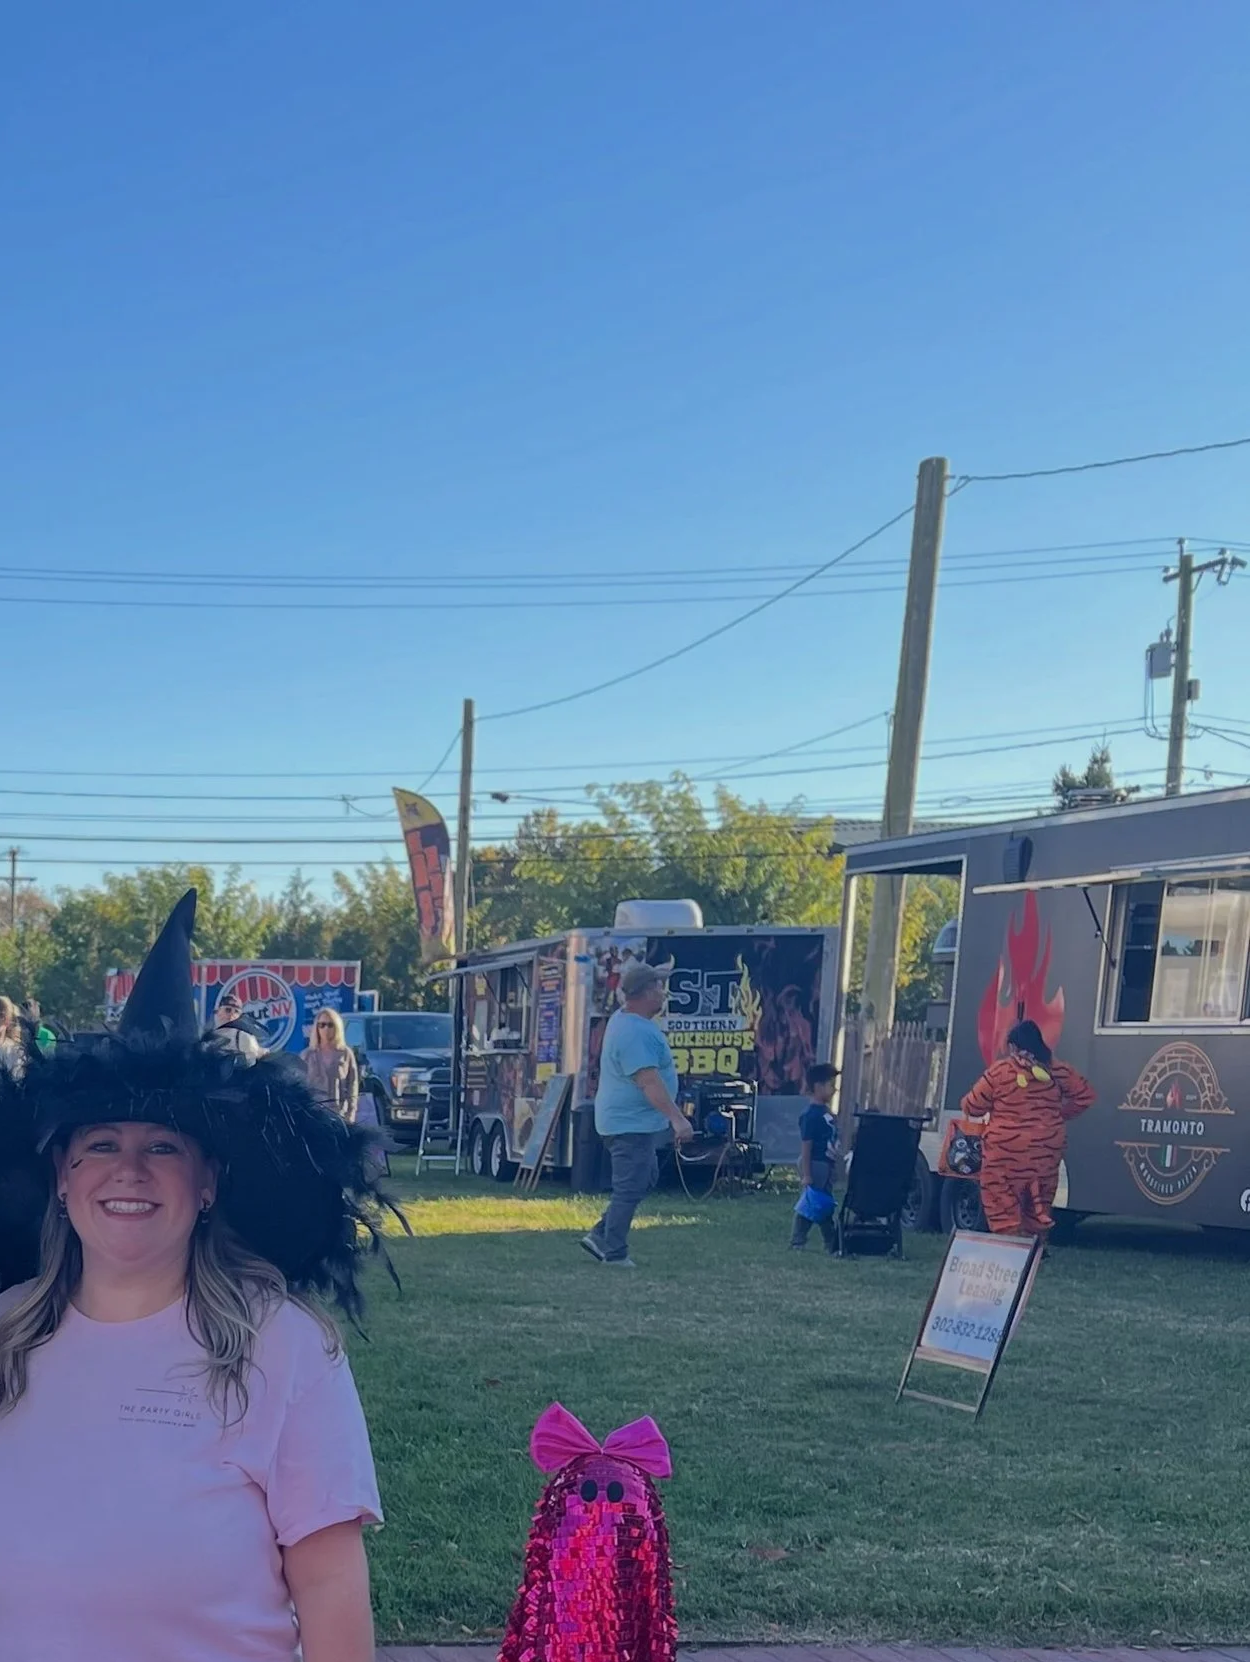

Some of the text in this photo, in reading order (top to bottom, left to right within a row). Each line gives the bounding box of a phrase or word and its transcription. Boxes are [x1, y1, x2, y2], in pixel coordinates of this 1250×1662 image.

[668, 1020, 737, 1030] SOUTHERN
[667, 1031, 755, 1051] MOKEHOUSE
[671, 1048, 741, 1077] BBQ
[1140, 1119, 1205, 1135] TRAMONTO
[949, 1256, 1021, 1284] Broad Stree
[959, 1280, 1006, 1306] Leasing
[119, 1404, 202, 1420] THE PARTY GIRLS
